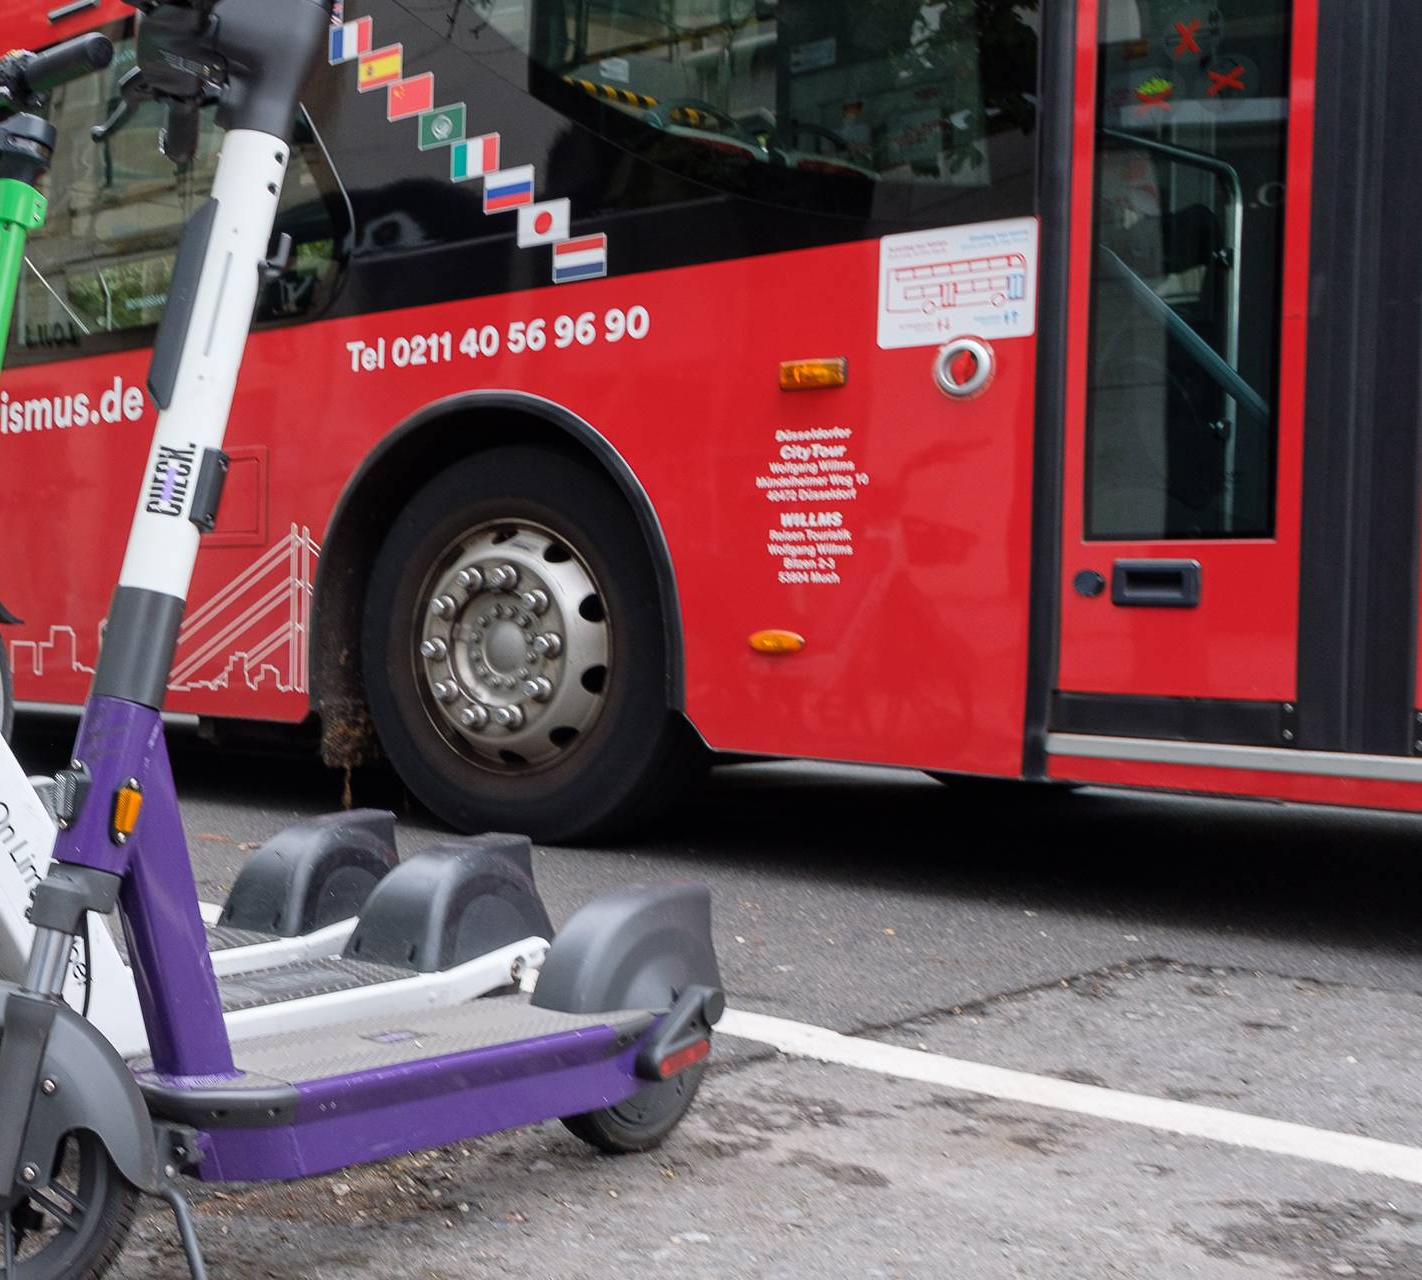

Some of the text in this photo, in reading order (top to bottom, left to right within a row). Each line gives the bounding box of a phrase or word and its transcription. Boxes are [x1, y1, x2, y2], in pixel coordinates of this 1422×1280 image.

[346, 305, 650, 372] Tel 0211 40 56 96 90
[775, 426, 852, 442] Düsseldorfer
[769, 460, 856, 475] Wolfgang Willms
[828, 474, 853, 487] Weg
[855, 472, 870, 485] 10
[798, 487, 857, 501] Düsseldorf
[780, 512, 843, 527] WILLMS
[769, 528, 851, 541] Reisen Touristik
[767, 543, 853, 557] Wolfgang Willms
[10, 840, 43, 885] Lim
